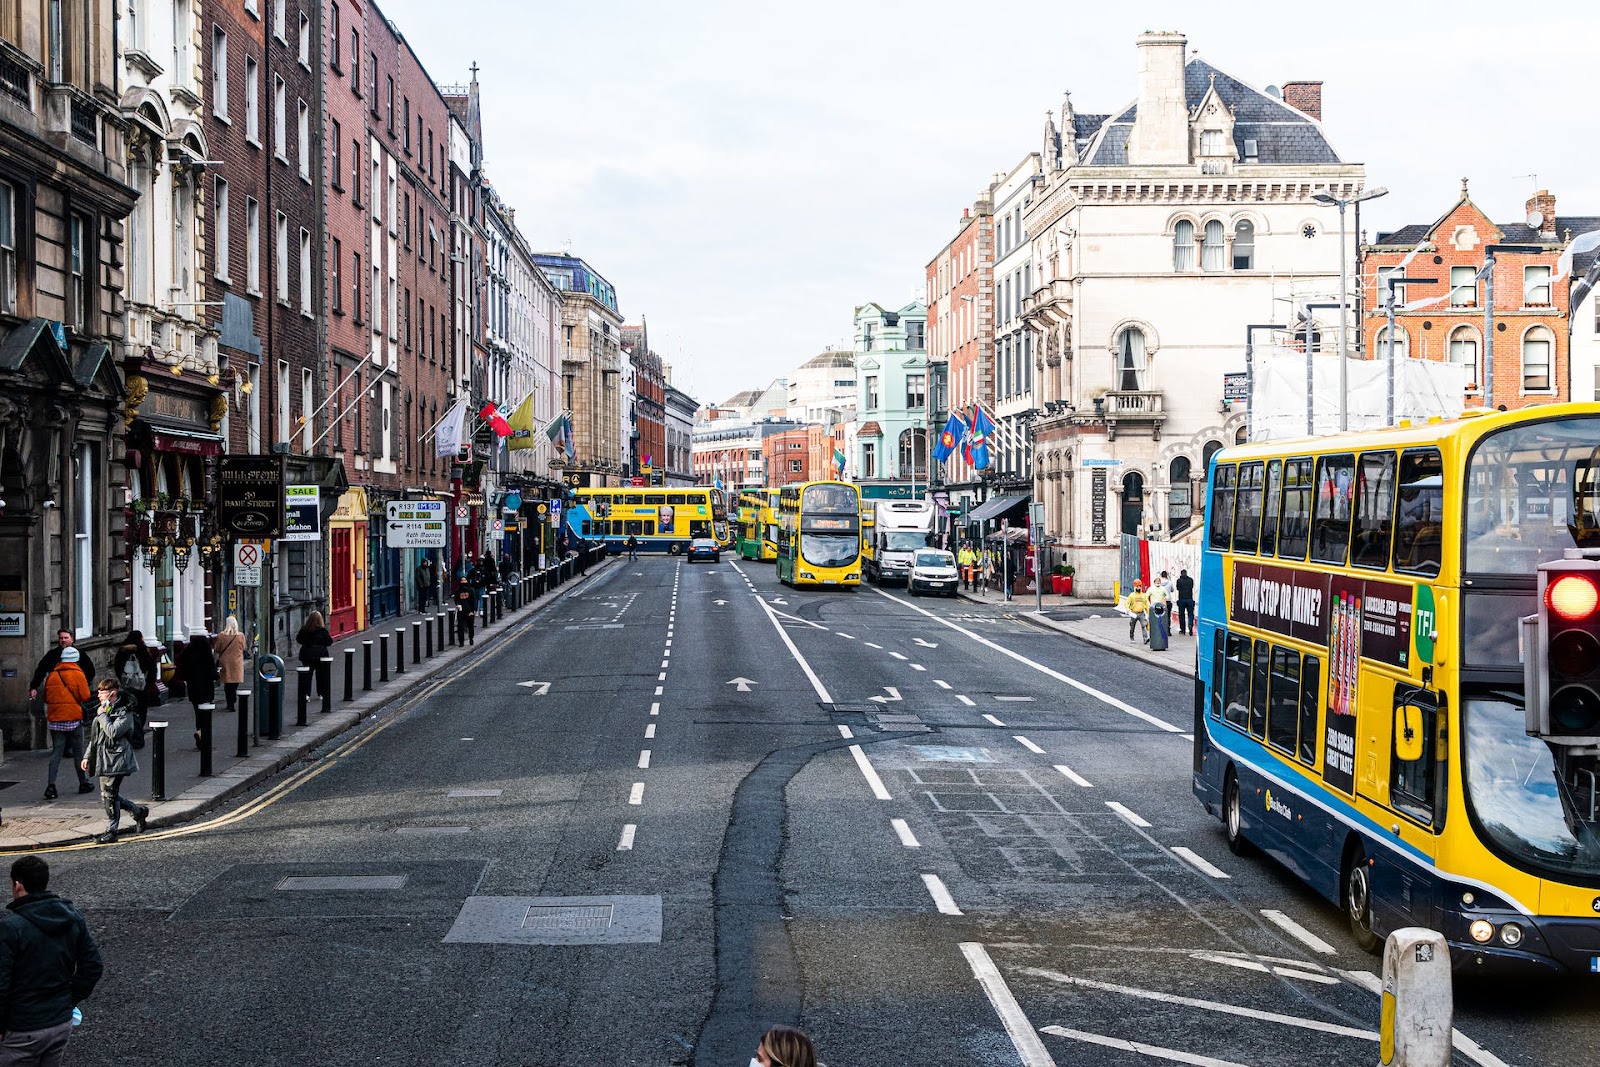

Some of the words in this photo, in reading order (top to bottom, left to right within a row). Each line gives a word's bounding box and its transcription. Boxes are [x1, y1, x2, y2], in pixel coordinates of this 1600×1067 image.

[1242, 576, 1260, 612] YOUR
[1260, 579, 1280, 616] STOP
[1280, 583, 1291, 620] OR
[1293, 586, 1322, 627] MINE?
